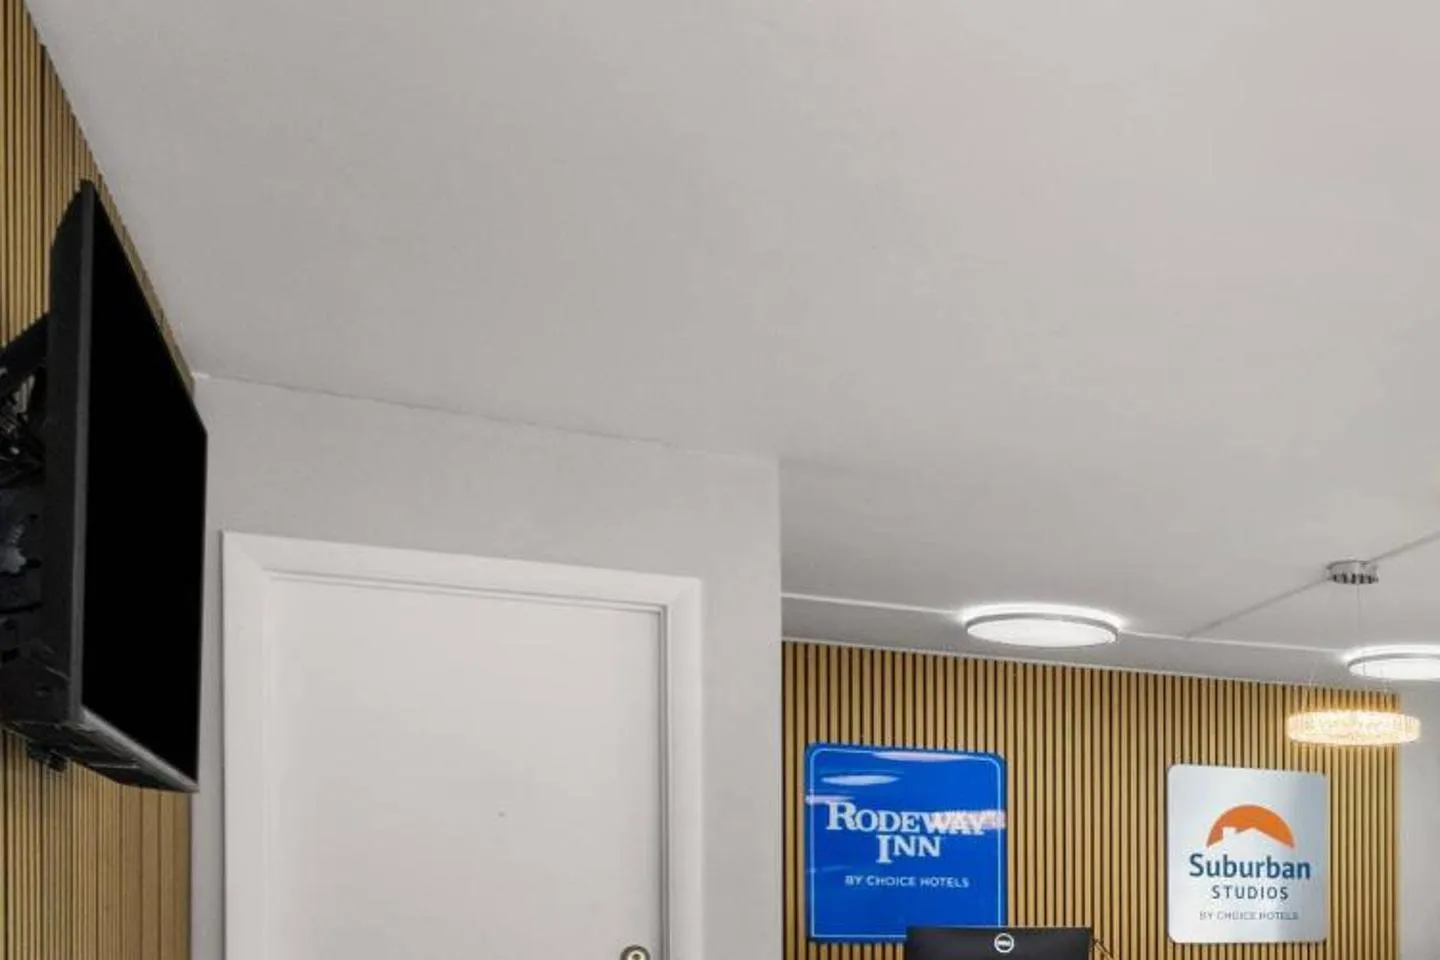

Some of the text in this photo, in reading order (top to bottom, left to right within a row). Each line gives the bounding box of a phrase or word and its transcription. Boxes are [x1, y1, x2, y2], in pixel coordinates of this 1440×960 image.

[826, 801, 985, 835] RODEWAY
[876, 835, 941, 863] INN
[1189, 853, 1311, 879] Suburban
[845, 876, 970, 888] BY CHOICE HOTELS
[1212, 885, 1289, 899] STUDIOS
[1199, 912, 1298, 920] BY CHOICE HOTELS
